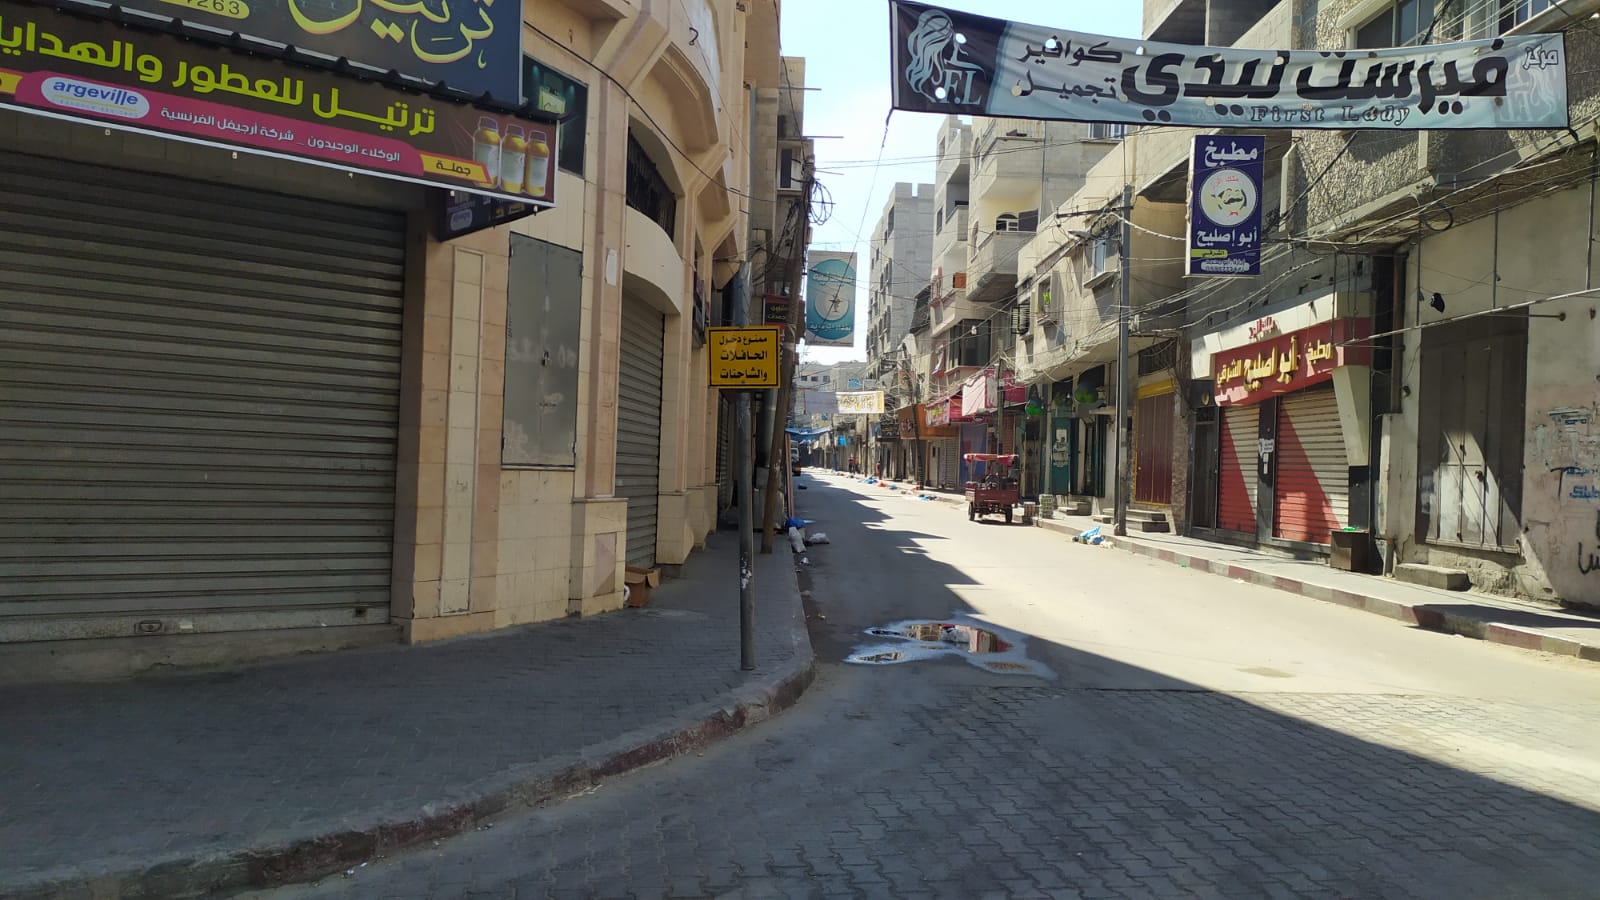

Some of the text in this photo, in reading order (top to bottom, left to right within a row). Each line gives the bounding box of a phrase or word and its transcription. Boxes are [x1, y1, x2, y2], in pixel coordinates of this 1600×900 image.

[1016, 35, 1122, 66] كوافير
[172, 61, 304, 105] للعطور
[1012, 69, 1117, 103] تجميل
[1121, 38, 1558, 122] مركز فيرست ليدي
[53, 81, 138, 105] argeville
[161, 107, 215, 126] الفرنسية
[217, 117, 258, 135] أرجيفل
[1251, 105, 1410, 126] First Lady
[260, 127, 294, 141] شركة
[307, 135, 359, 156] الوحيدون
[361, 148, 401, 162] الوكلاء
[1205, 140, 1258, 167] مطبخ
[1238, 226, 1257, 248] أبو
[719, 334, 768, 346] ممنوع دخول
[720, 349, 768, 361] الحافلات
[1277, 335, 1299, 384] أبو
[1306, 339, 1334, 367] مطبخ
[719, 366, 768, 382] والشاحنات
[1217, 358, 1242, 388] الشرقي
